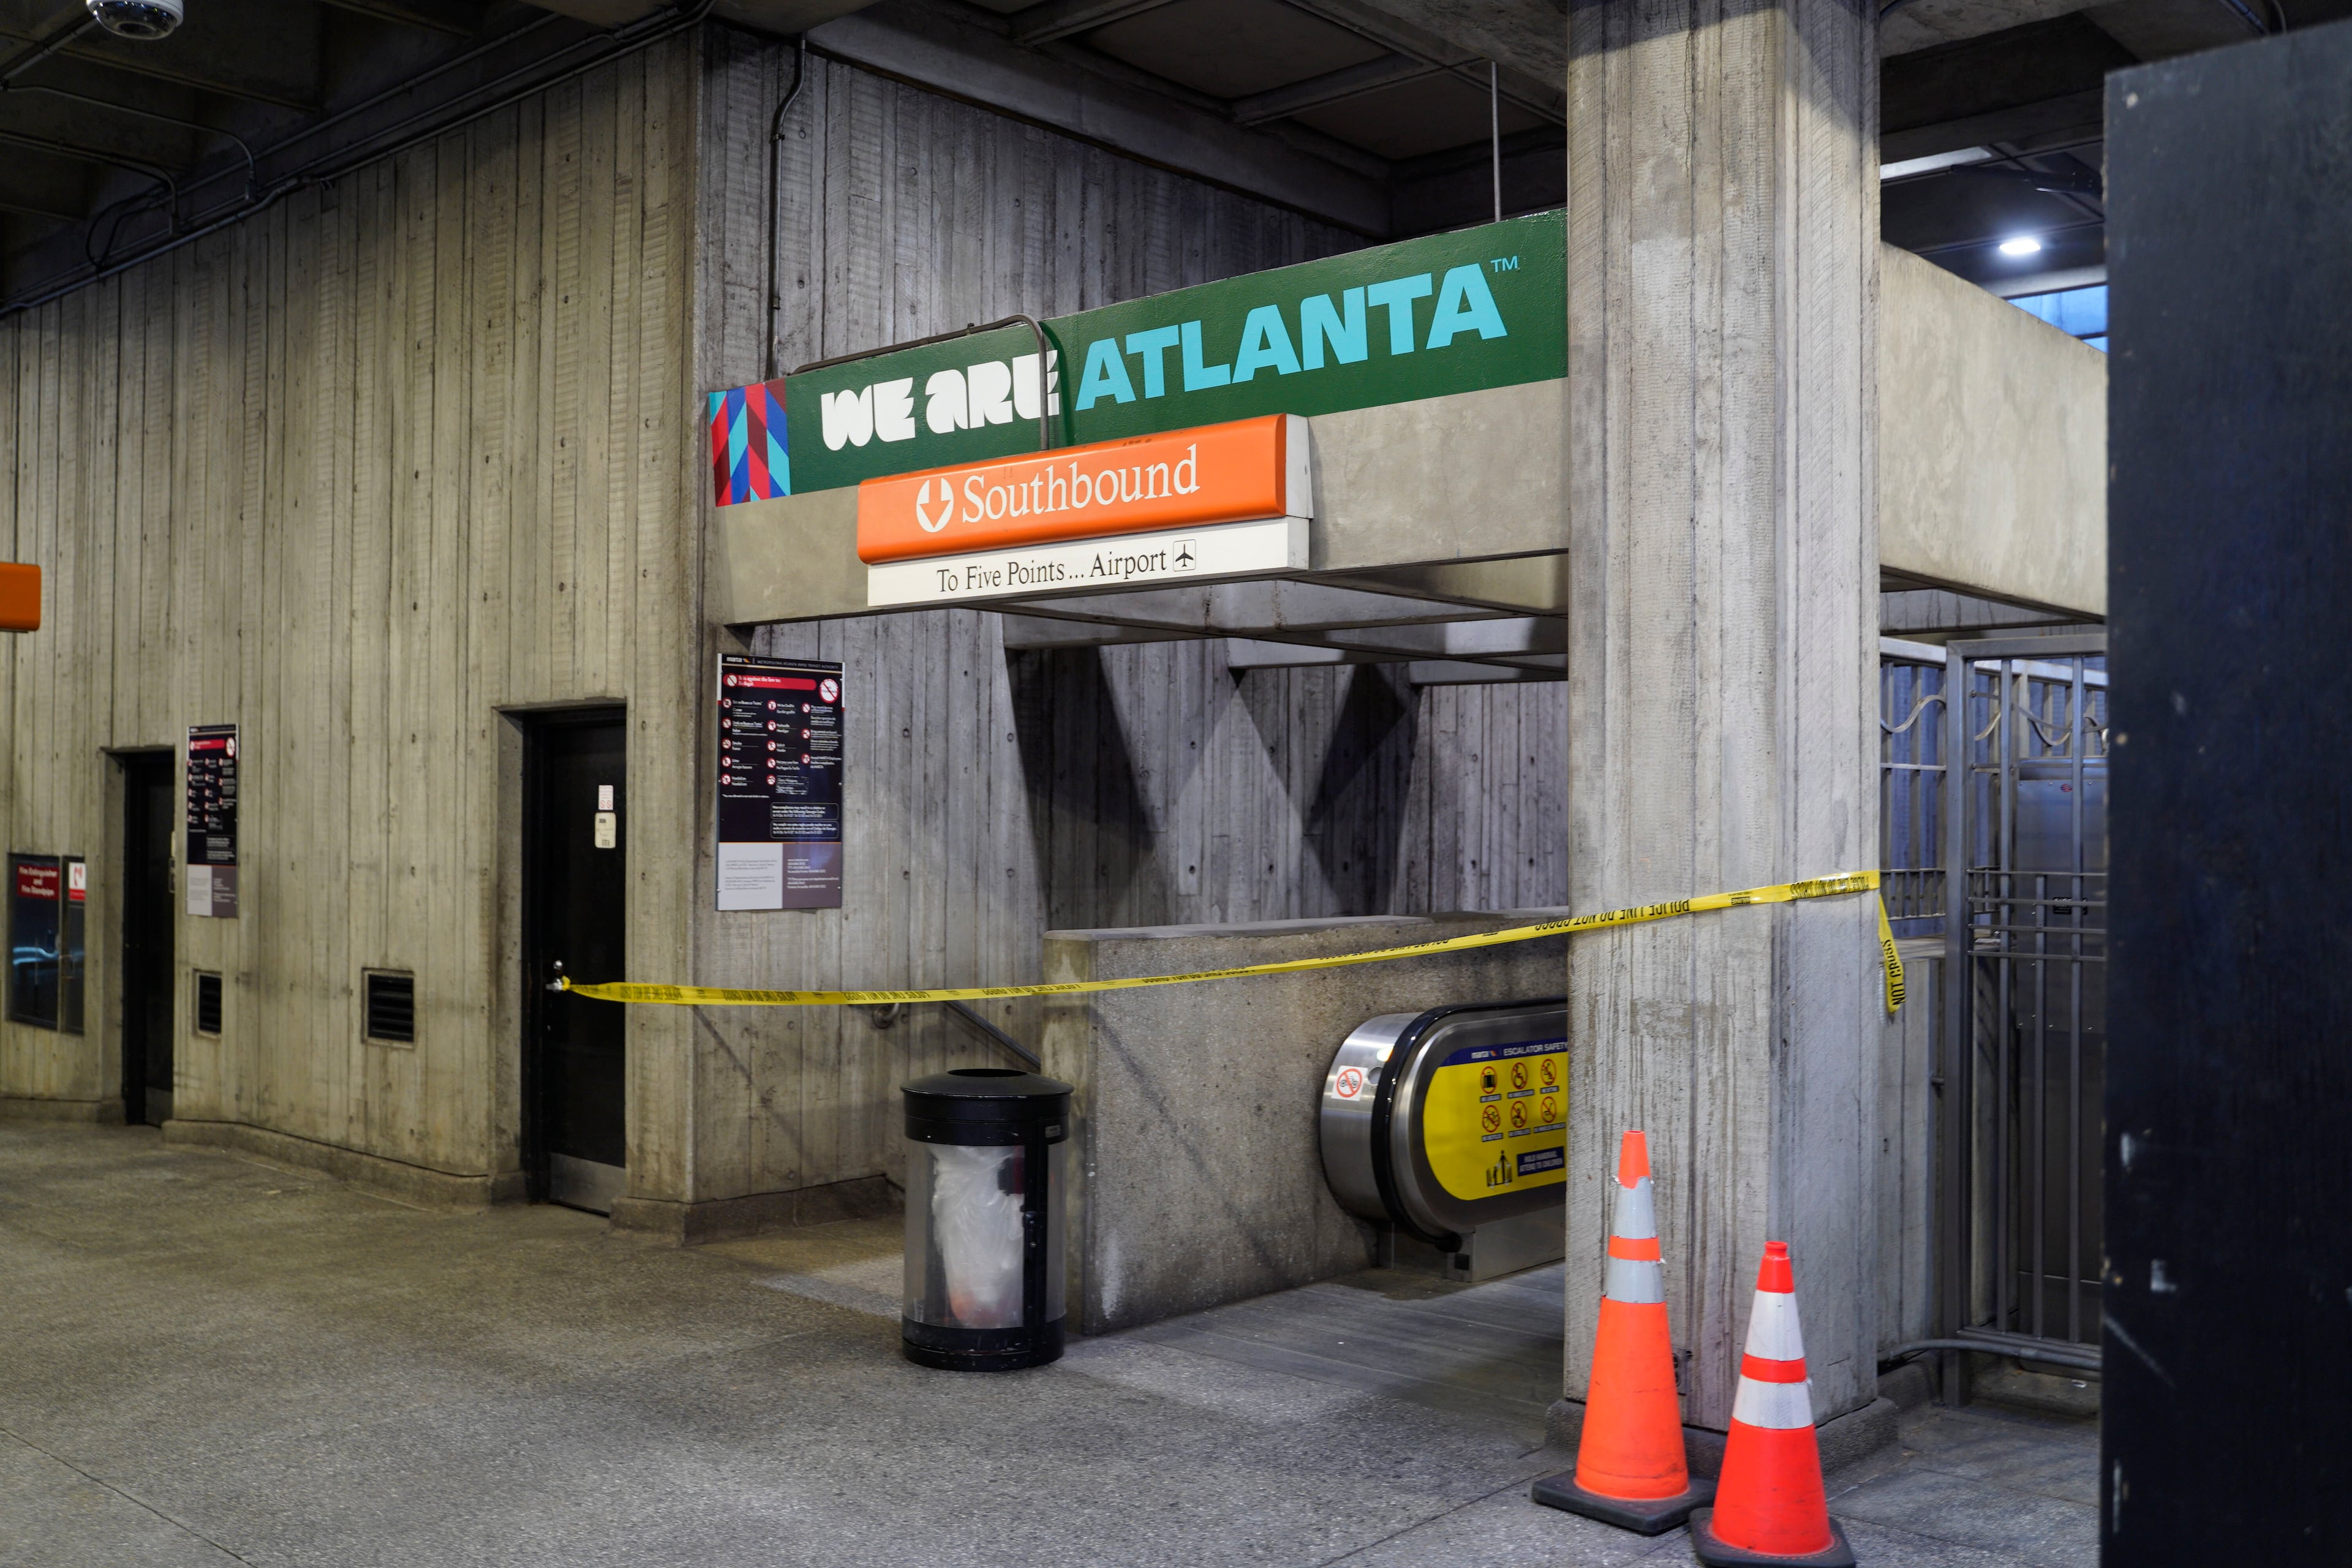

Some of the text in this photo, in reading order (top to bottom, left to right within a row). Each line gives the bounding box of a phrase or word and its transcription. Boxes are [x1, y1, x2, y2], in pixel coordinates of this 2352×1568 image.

[821, 377, 916, 451] WE
[925, 350, 1060, 434] ARE
[1075, 263, 1507, 412] ATLANTA
[962, 444, 1200, 524] Southbound
[937, 568, 958, 592] To
[965, 565, 1001, 590] Five
[1090, 549, 1166, 579] Airport
[1891, 982, 1906, 1006] NOT
[1503, 1044, 1543, 1056] ESCALATOR
